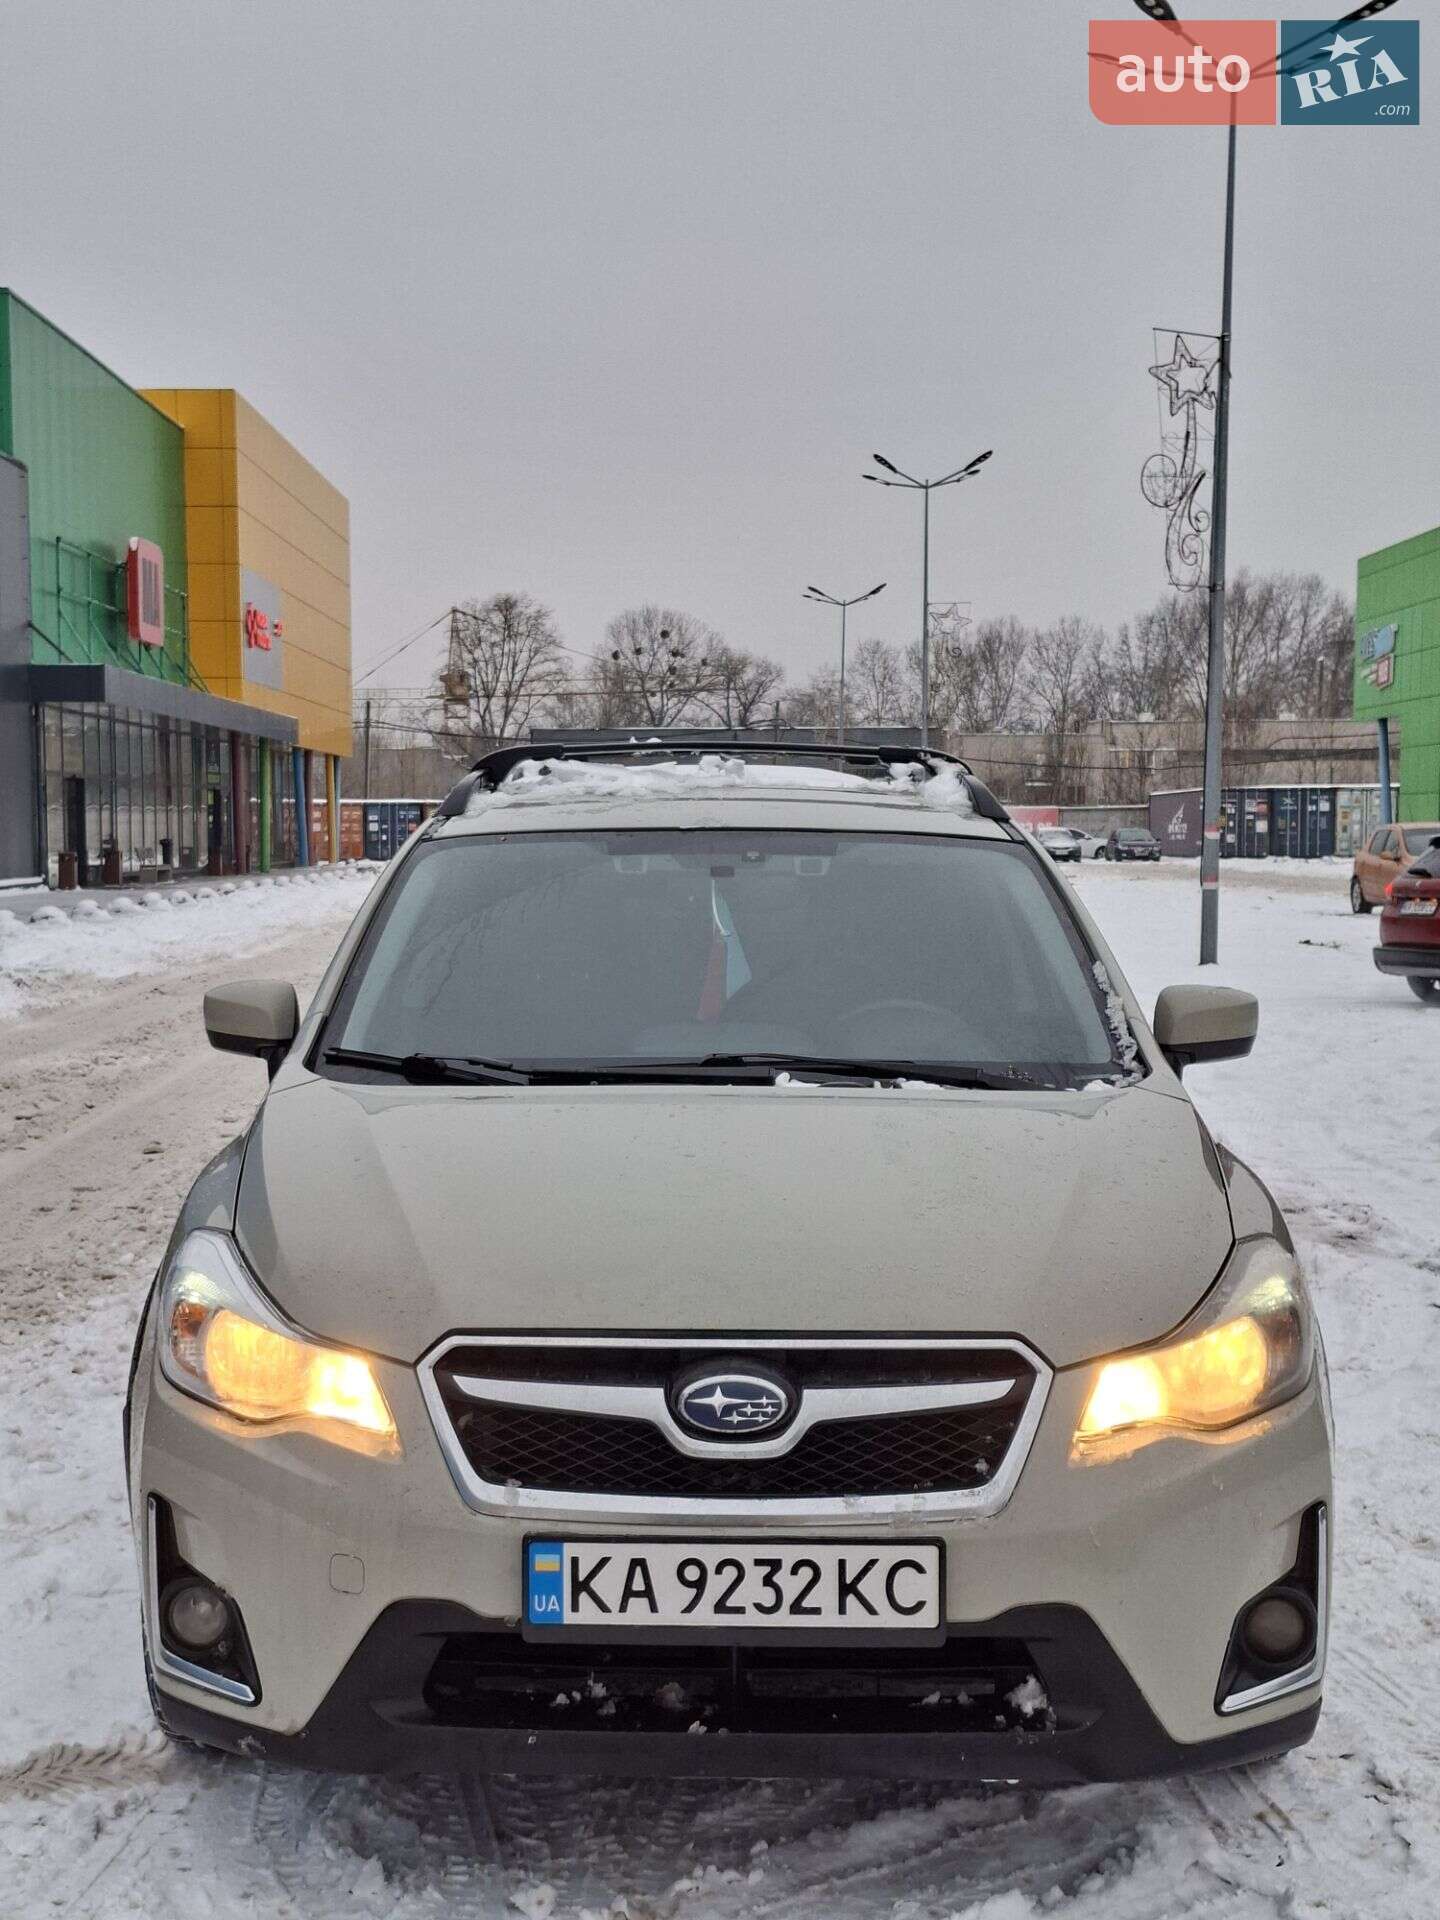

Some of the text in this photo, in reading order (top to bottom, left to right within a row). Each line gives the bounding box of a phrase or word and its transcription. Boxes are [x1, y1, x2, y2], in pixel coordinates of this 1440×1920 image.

[534, 1595, 561, 1613] UA
[570, 1555, 928, 1616] KA 9232 KC
